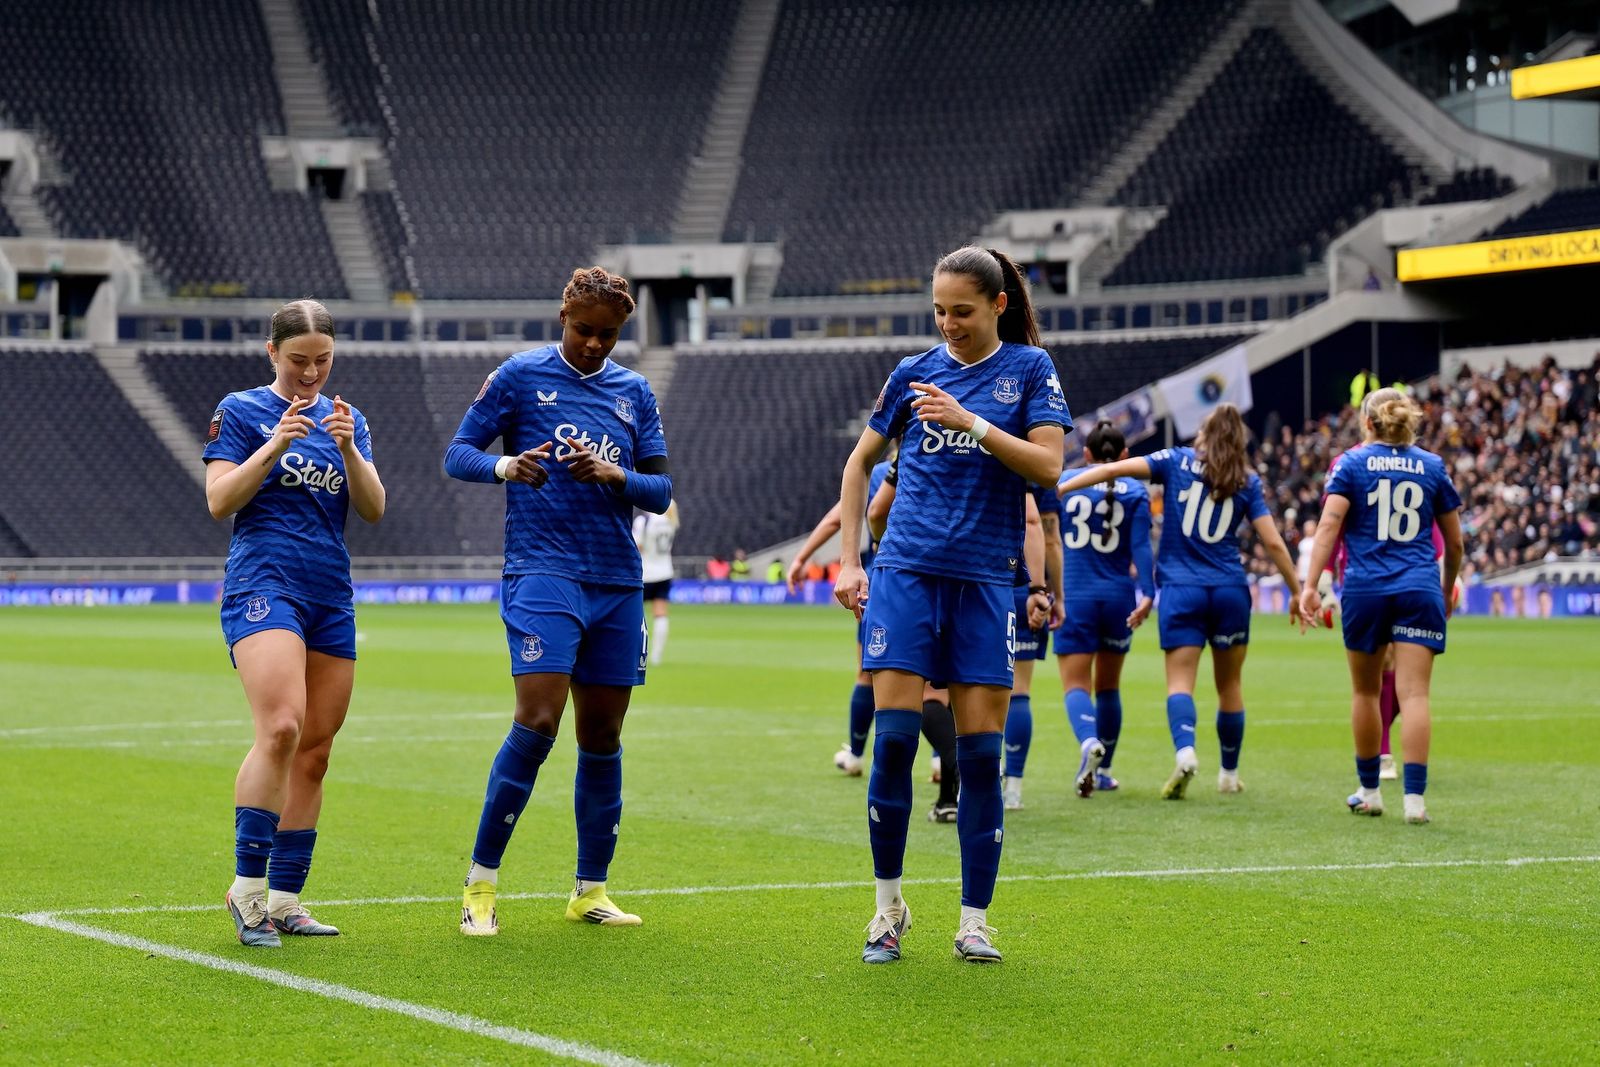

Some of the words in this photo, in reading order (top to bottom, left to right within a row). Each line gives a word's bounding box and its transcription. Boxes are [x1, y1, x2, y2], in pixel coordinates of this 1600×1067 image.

[1488, 241, 1553, 264] DRIVING
[922, 420, 993, 455] Sta
[280, 452, 344, 495] Stake
[1366, 455, 1425, 476] ORNELLA
[1064, 494, 1124, 553] 33
[1177, 480, 1234, 544] 10
[1367, 478, 1424, 542] 18
[1006, 611, 1016, 654] 5
